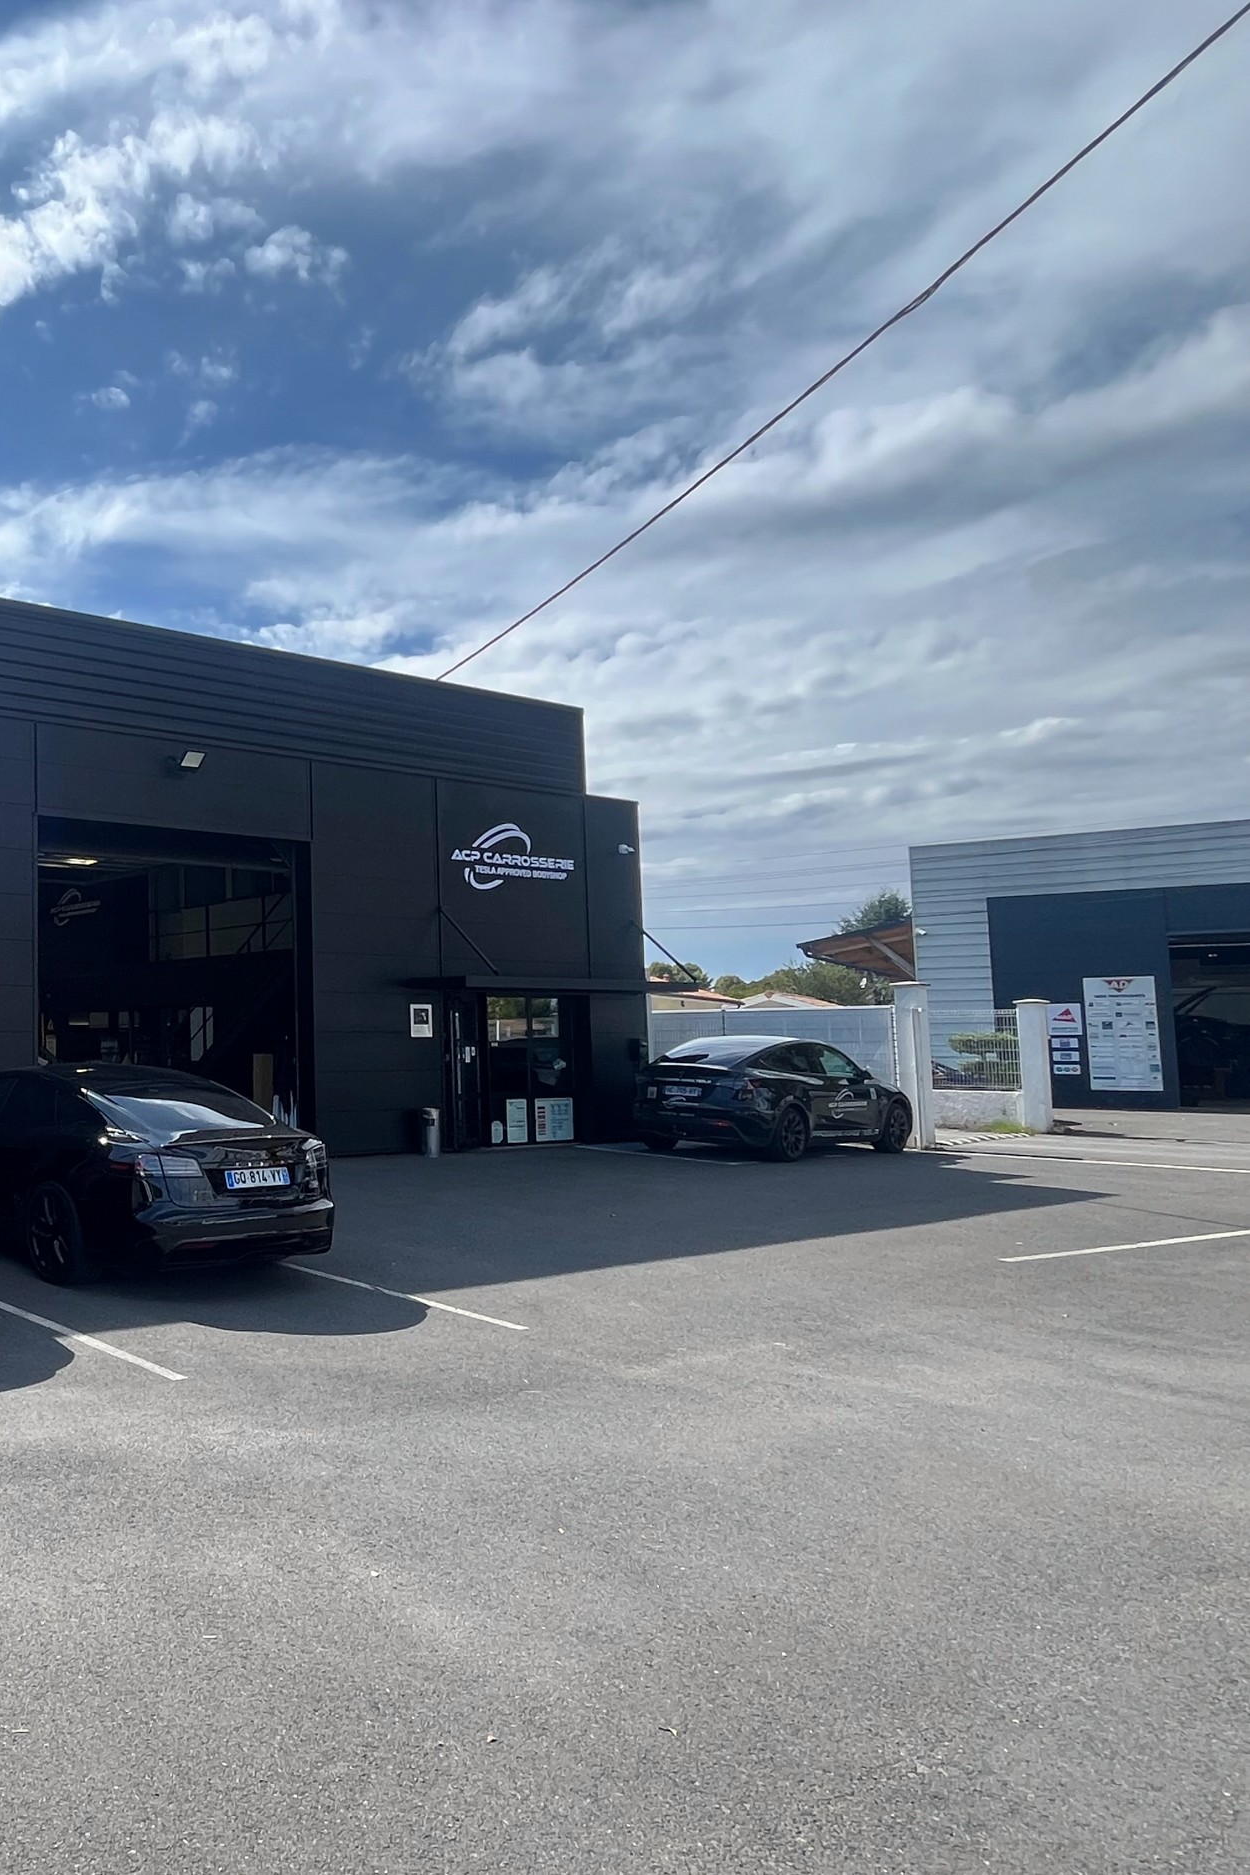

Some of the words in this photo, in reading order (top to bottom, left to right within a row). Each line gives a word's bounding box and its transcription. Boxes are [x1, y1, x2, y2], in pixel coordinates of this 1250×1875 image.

[451, 849, 481, 861] ACP
[483, 853, 574, 870] CARROSSERIE
[474, 865, 496, 874] TESLA
[533, 869, 567, 880] BODYSHOP
